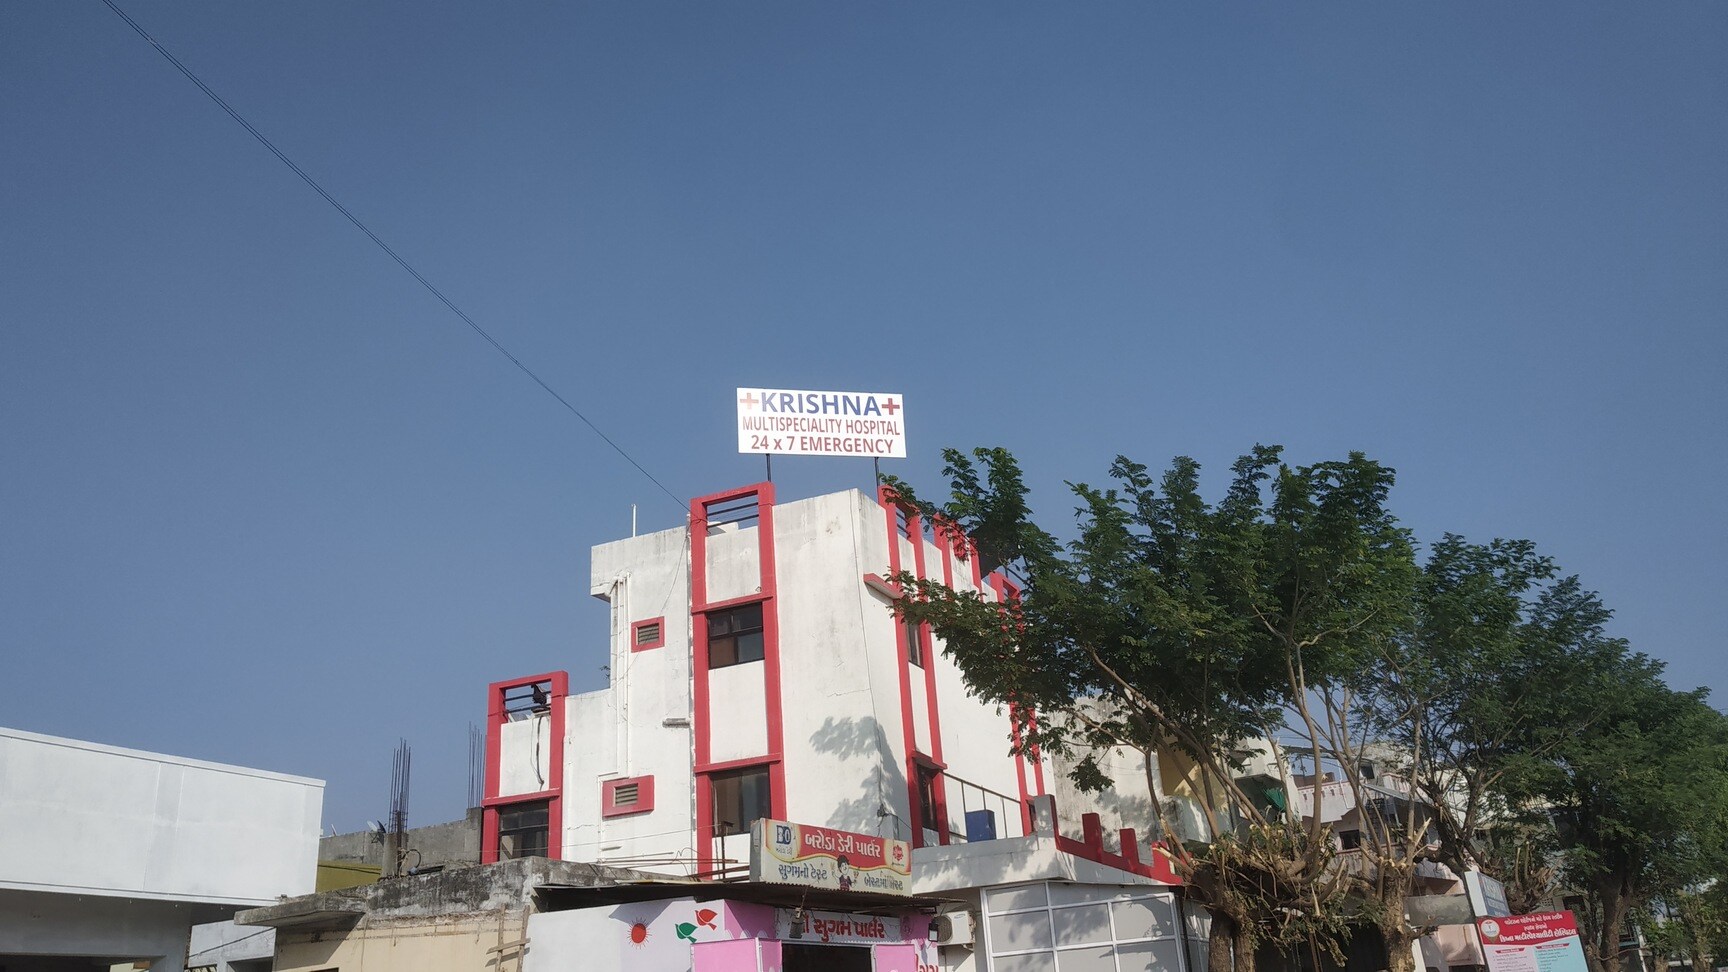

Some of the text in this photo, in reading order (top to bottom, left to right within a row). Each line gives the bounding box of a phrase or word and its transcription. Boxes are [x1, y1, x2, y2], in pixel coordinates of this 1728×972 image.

[761, 392, 881, 416] KRISHNA
[742, 416, 901, 436] MULTISPECIALITY HOSPITAL
[751, 435, 769, 450] 24
[786, 436, 795, 451] 7
[800, 436, 893, 454] EMERGENCY
[805, 830, 881, 857] બરોડા ડેરી પાર્લર
[813, 918, 852, 943] સુગમ
[855, 916, 885, 939] પાર્લર
